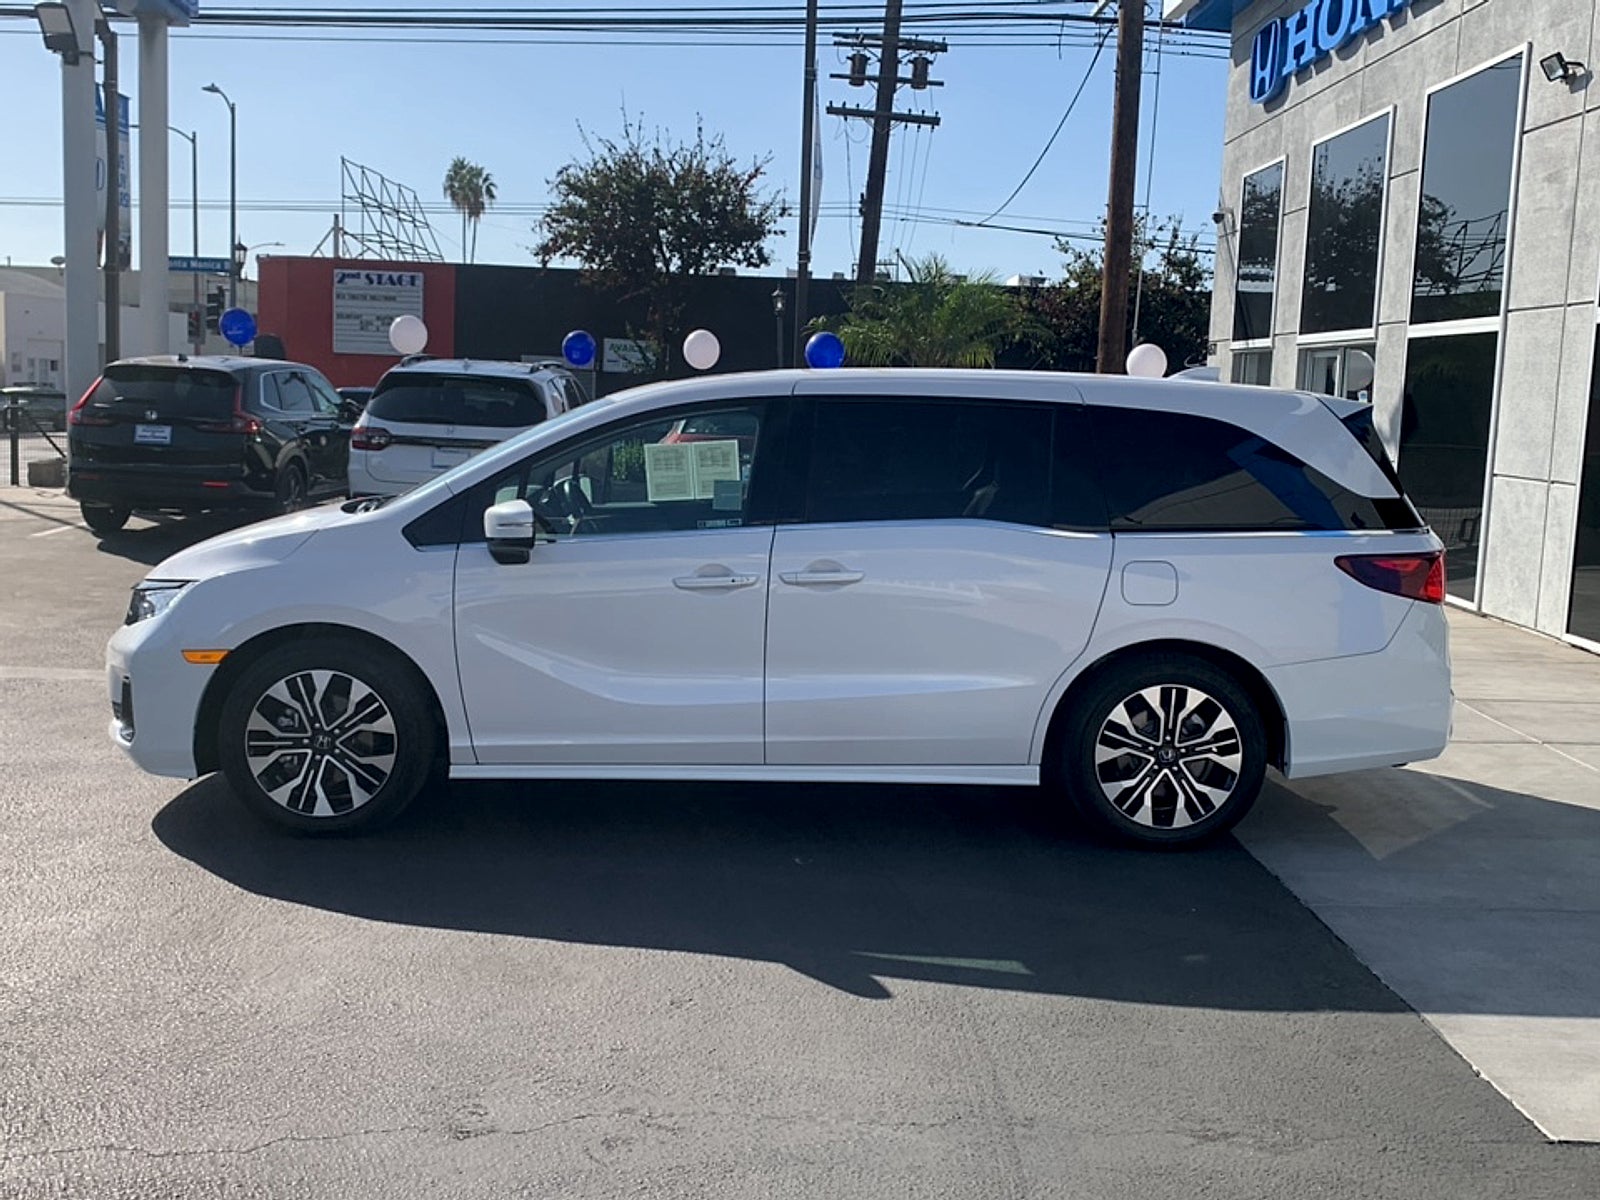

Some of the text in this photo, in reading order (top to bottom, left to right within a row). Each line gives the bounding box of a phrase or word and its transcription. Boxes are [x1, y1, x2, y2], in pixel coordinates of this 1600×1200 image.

[1282, 0, 1404, 76] HON
[336, 272, 420, 287] 2nd STAGE
